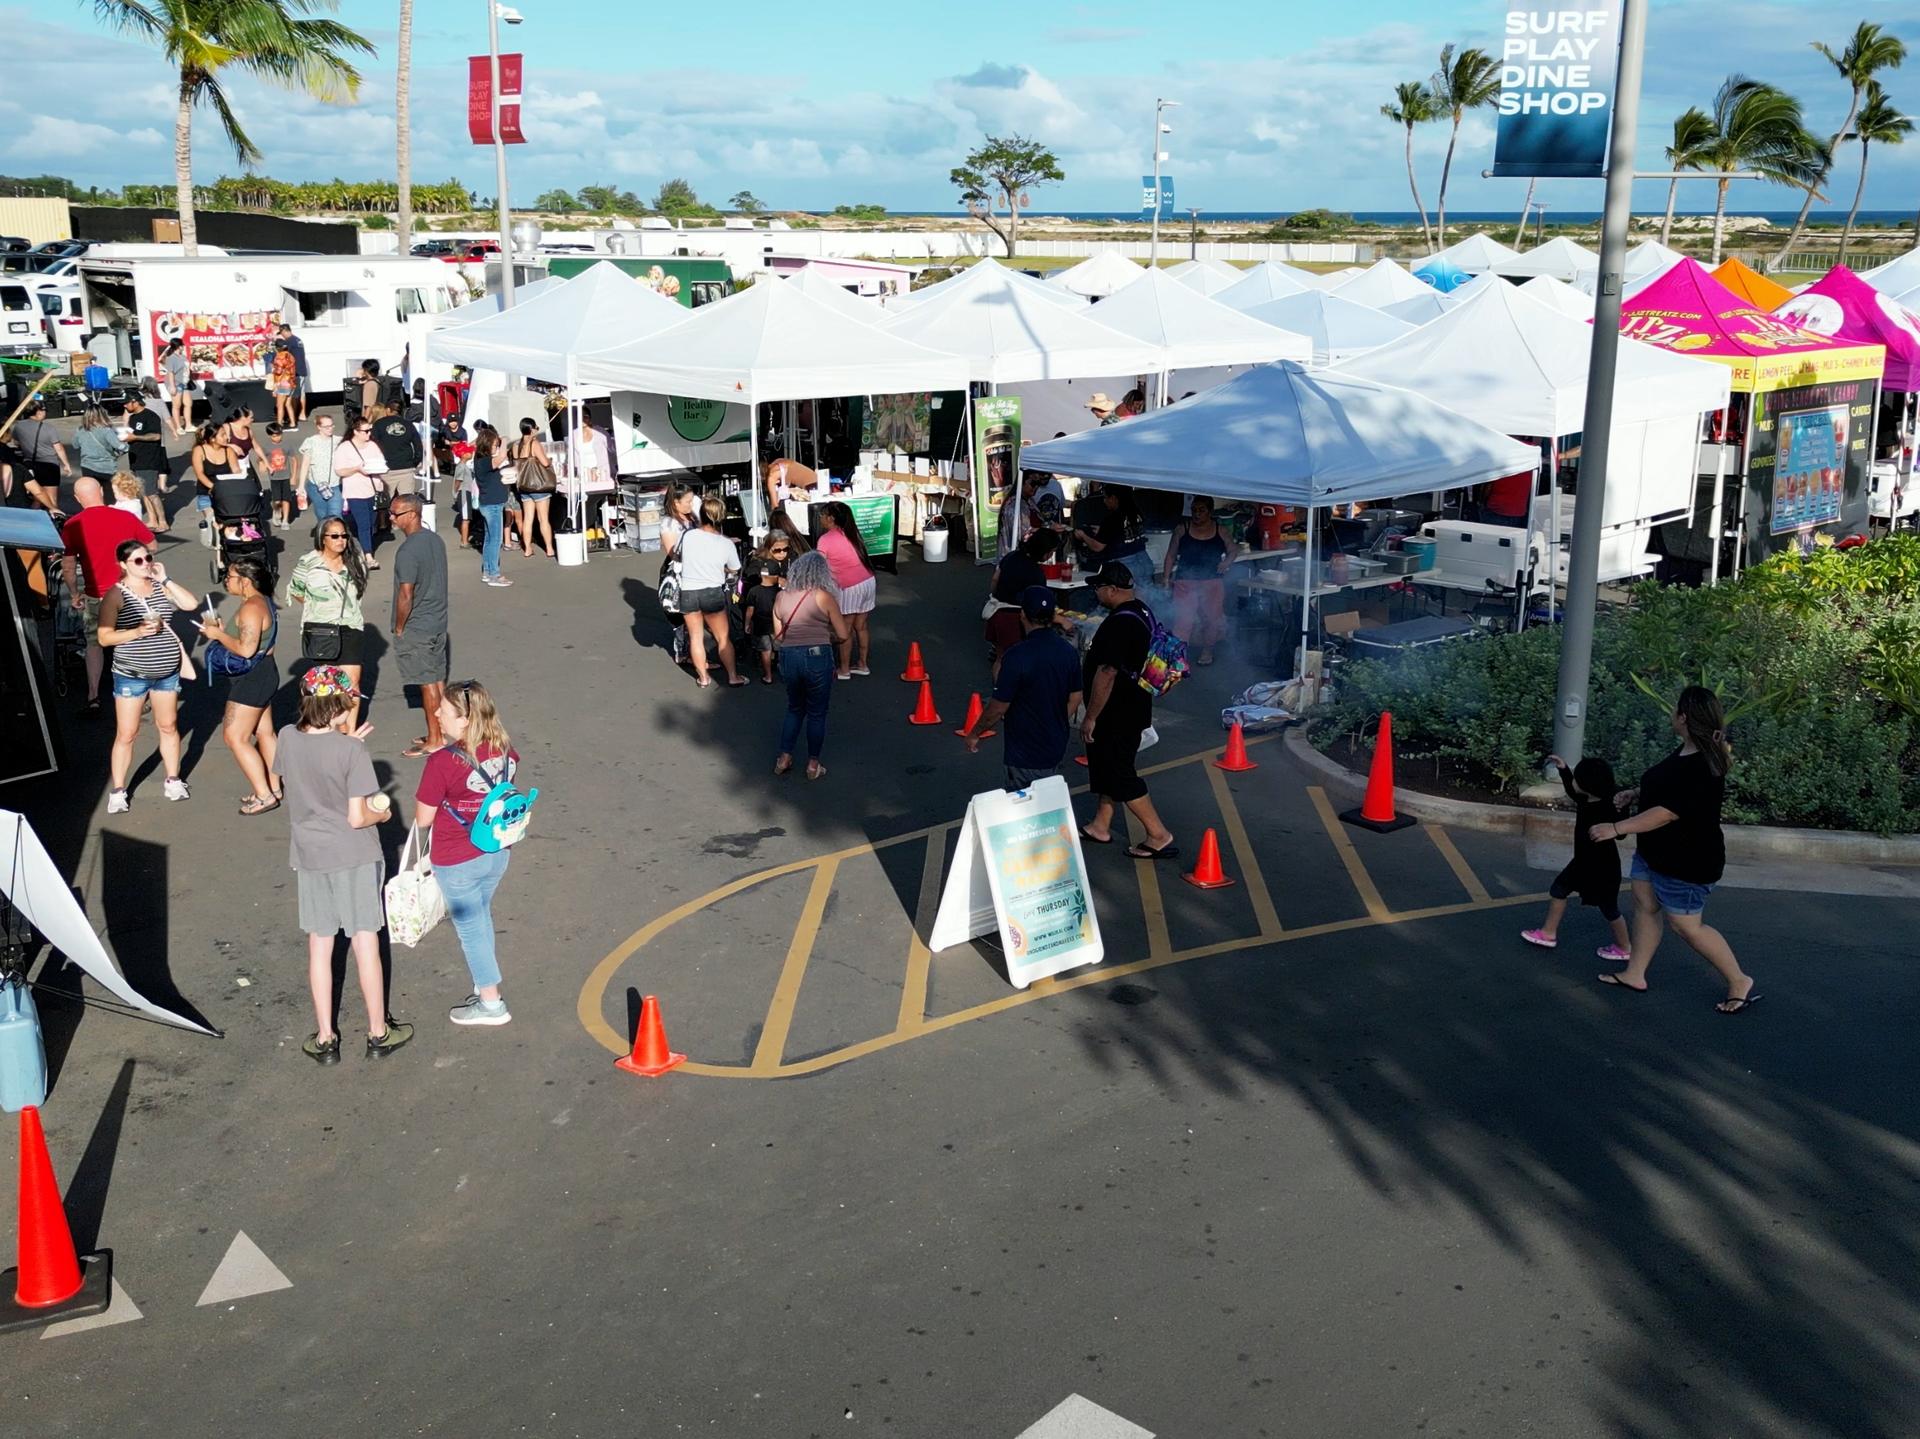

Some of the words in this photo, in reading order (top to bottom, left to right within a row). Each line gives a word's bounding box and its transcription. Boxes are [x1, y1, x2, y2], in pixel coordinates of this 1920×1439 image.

[1505, 11, 1609, 34] SURF
[1503, 38, 1600, 60] PLAY
[1501, 65, 1591, 88] DINE
[1499, 92, 1606, 115] SHOP
[1731, 367, 1750, 380] ORE
[683, 400, 712, 410] Health
[683, 411, 700, 420] Bar
[1036, 897, 1070, 915] THURSDAY
